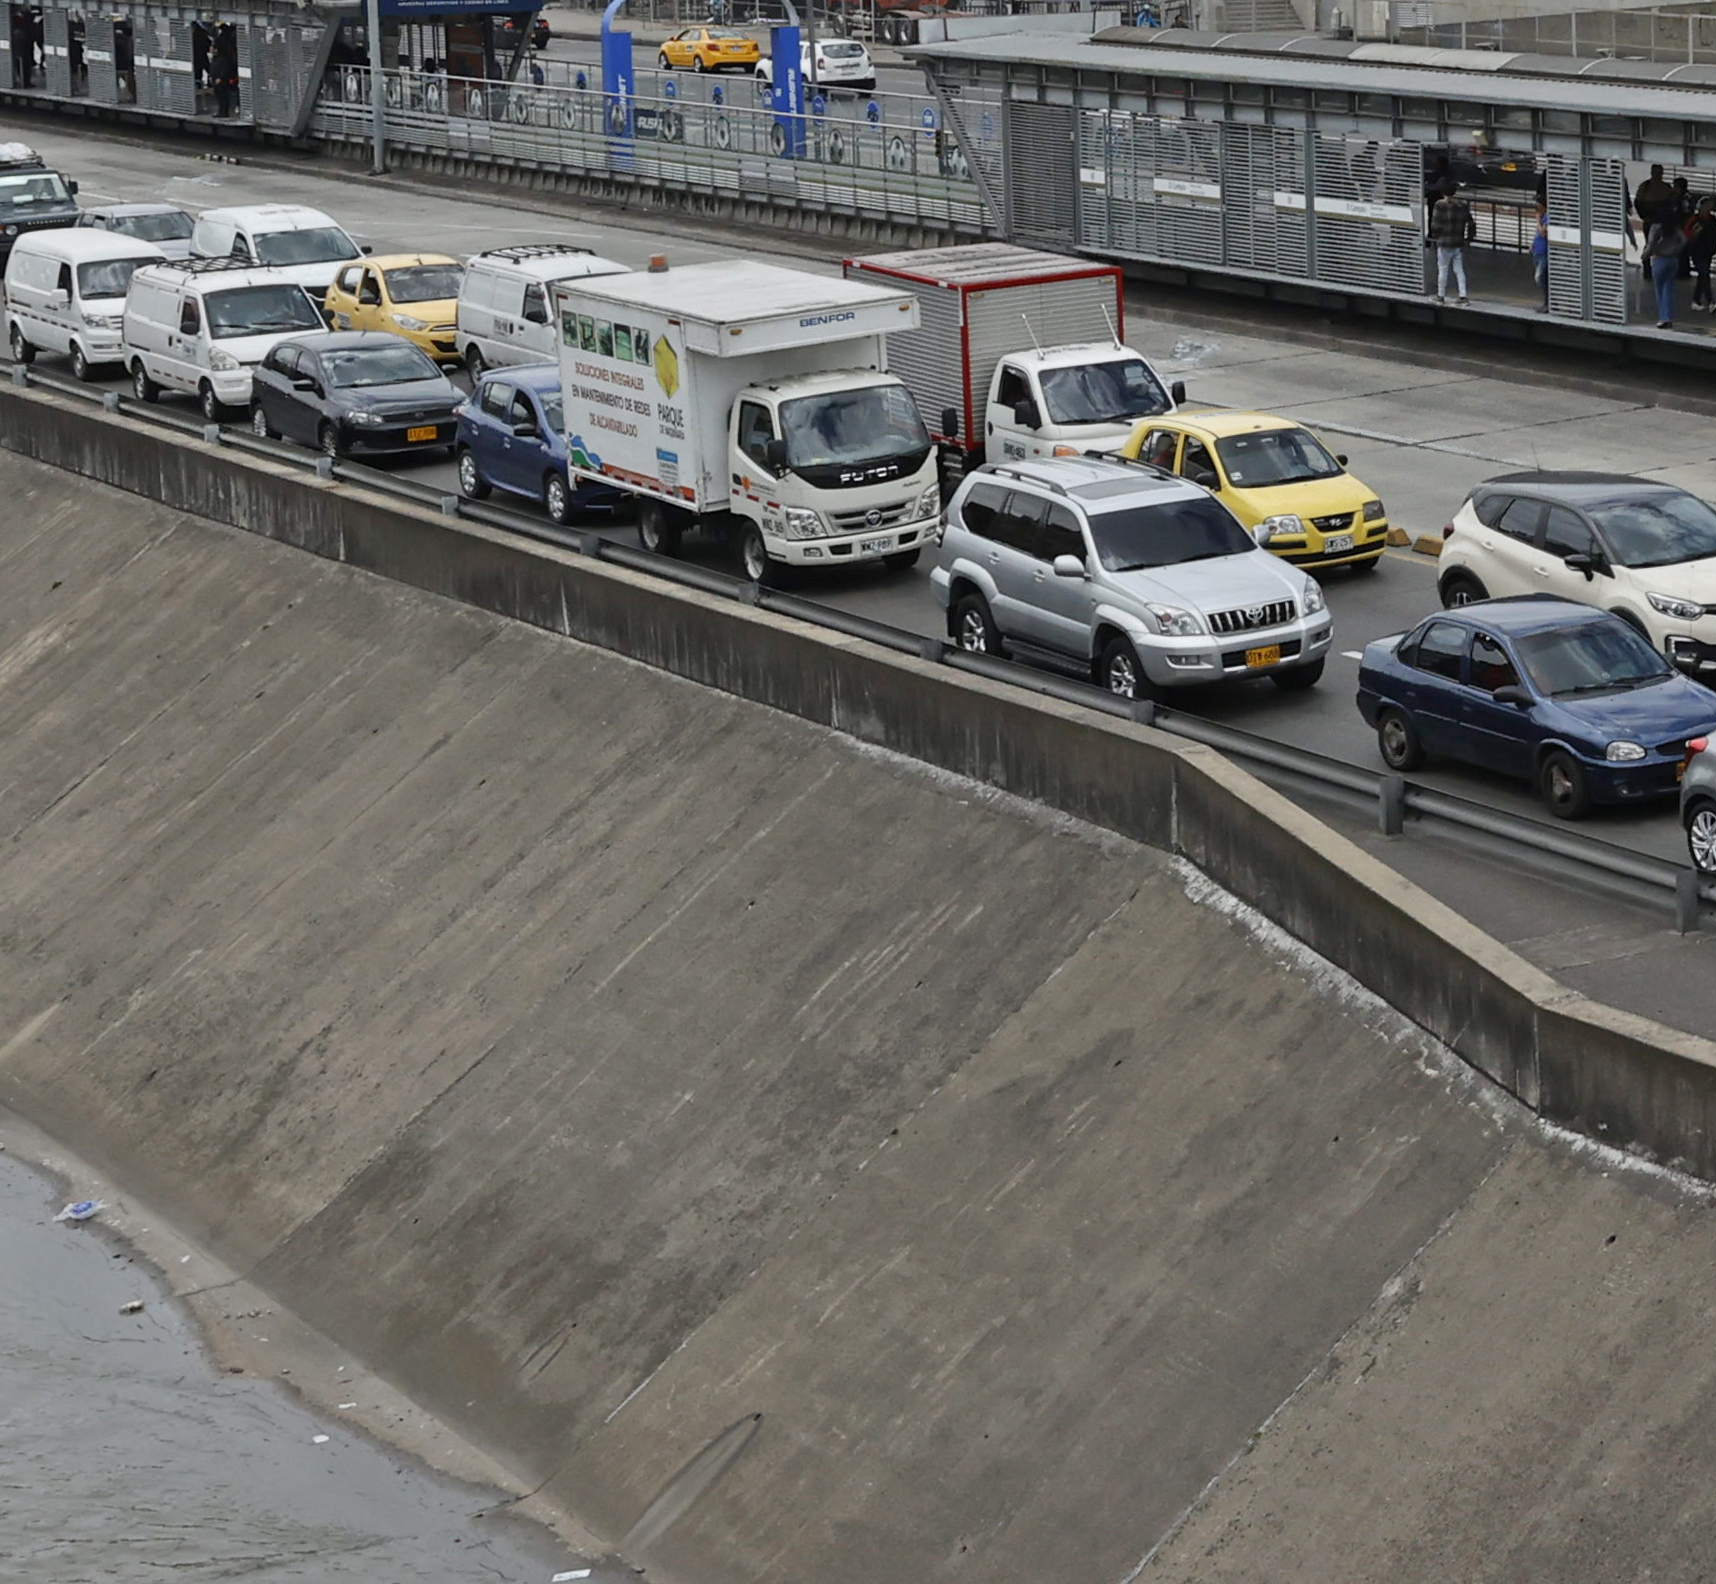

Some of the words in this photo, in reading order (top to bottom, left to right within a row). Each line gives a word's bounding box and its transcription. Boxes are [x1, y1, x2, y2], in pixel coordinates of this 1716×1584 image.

[799, 311, 855, 328] BENFOR
[575, 362, 609, 383] SOLUCIONES
[610, 371, 645, 391] INTEGRALES
[572, 384, 580, 397] EN
[581, 386, 624, 410] MANTENIMIENTO
[624, 397, 633, 412] DE
[633, 400, 651, 417] REDES
[657, 403, 684, 428] PARQUE
